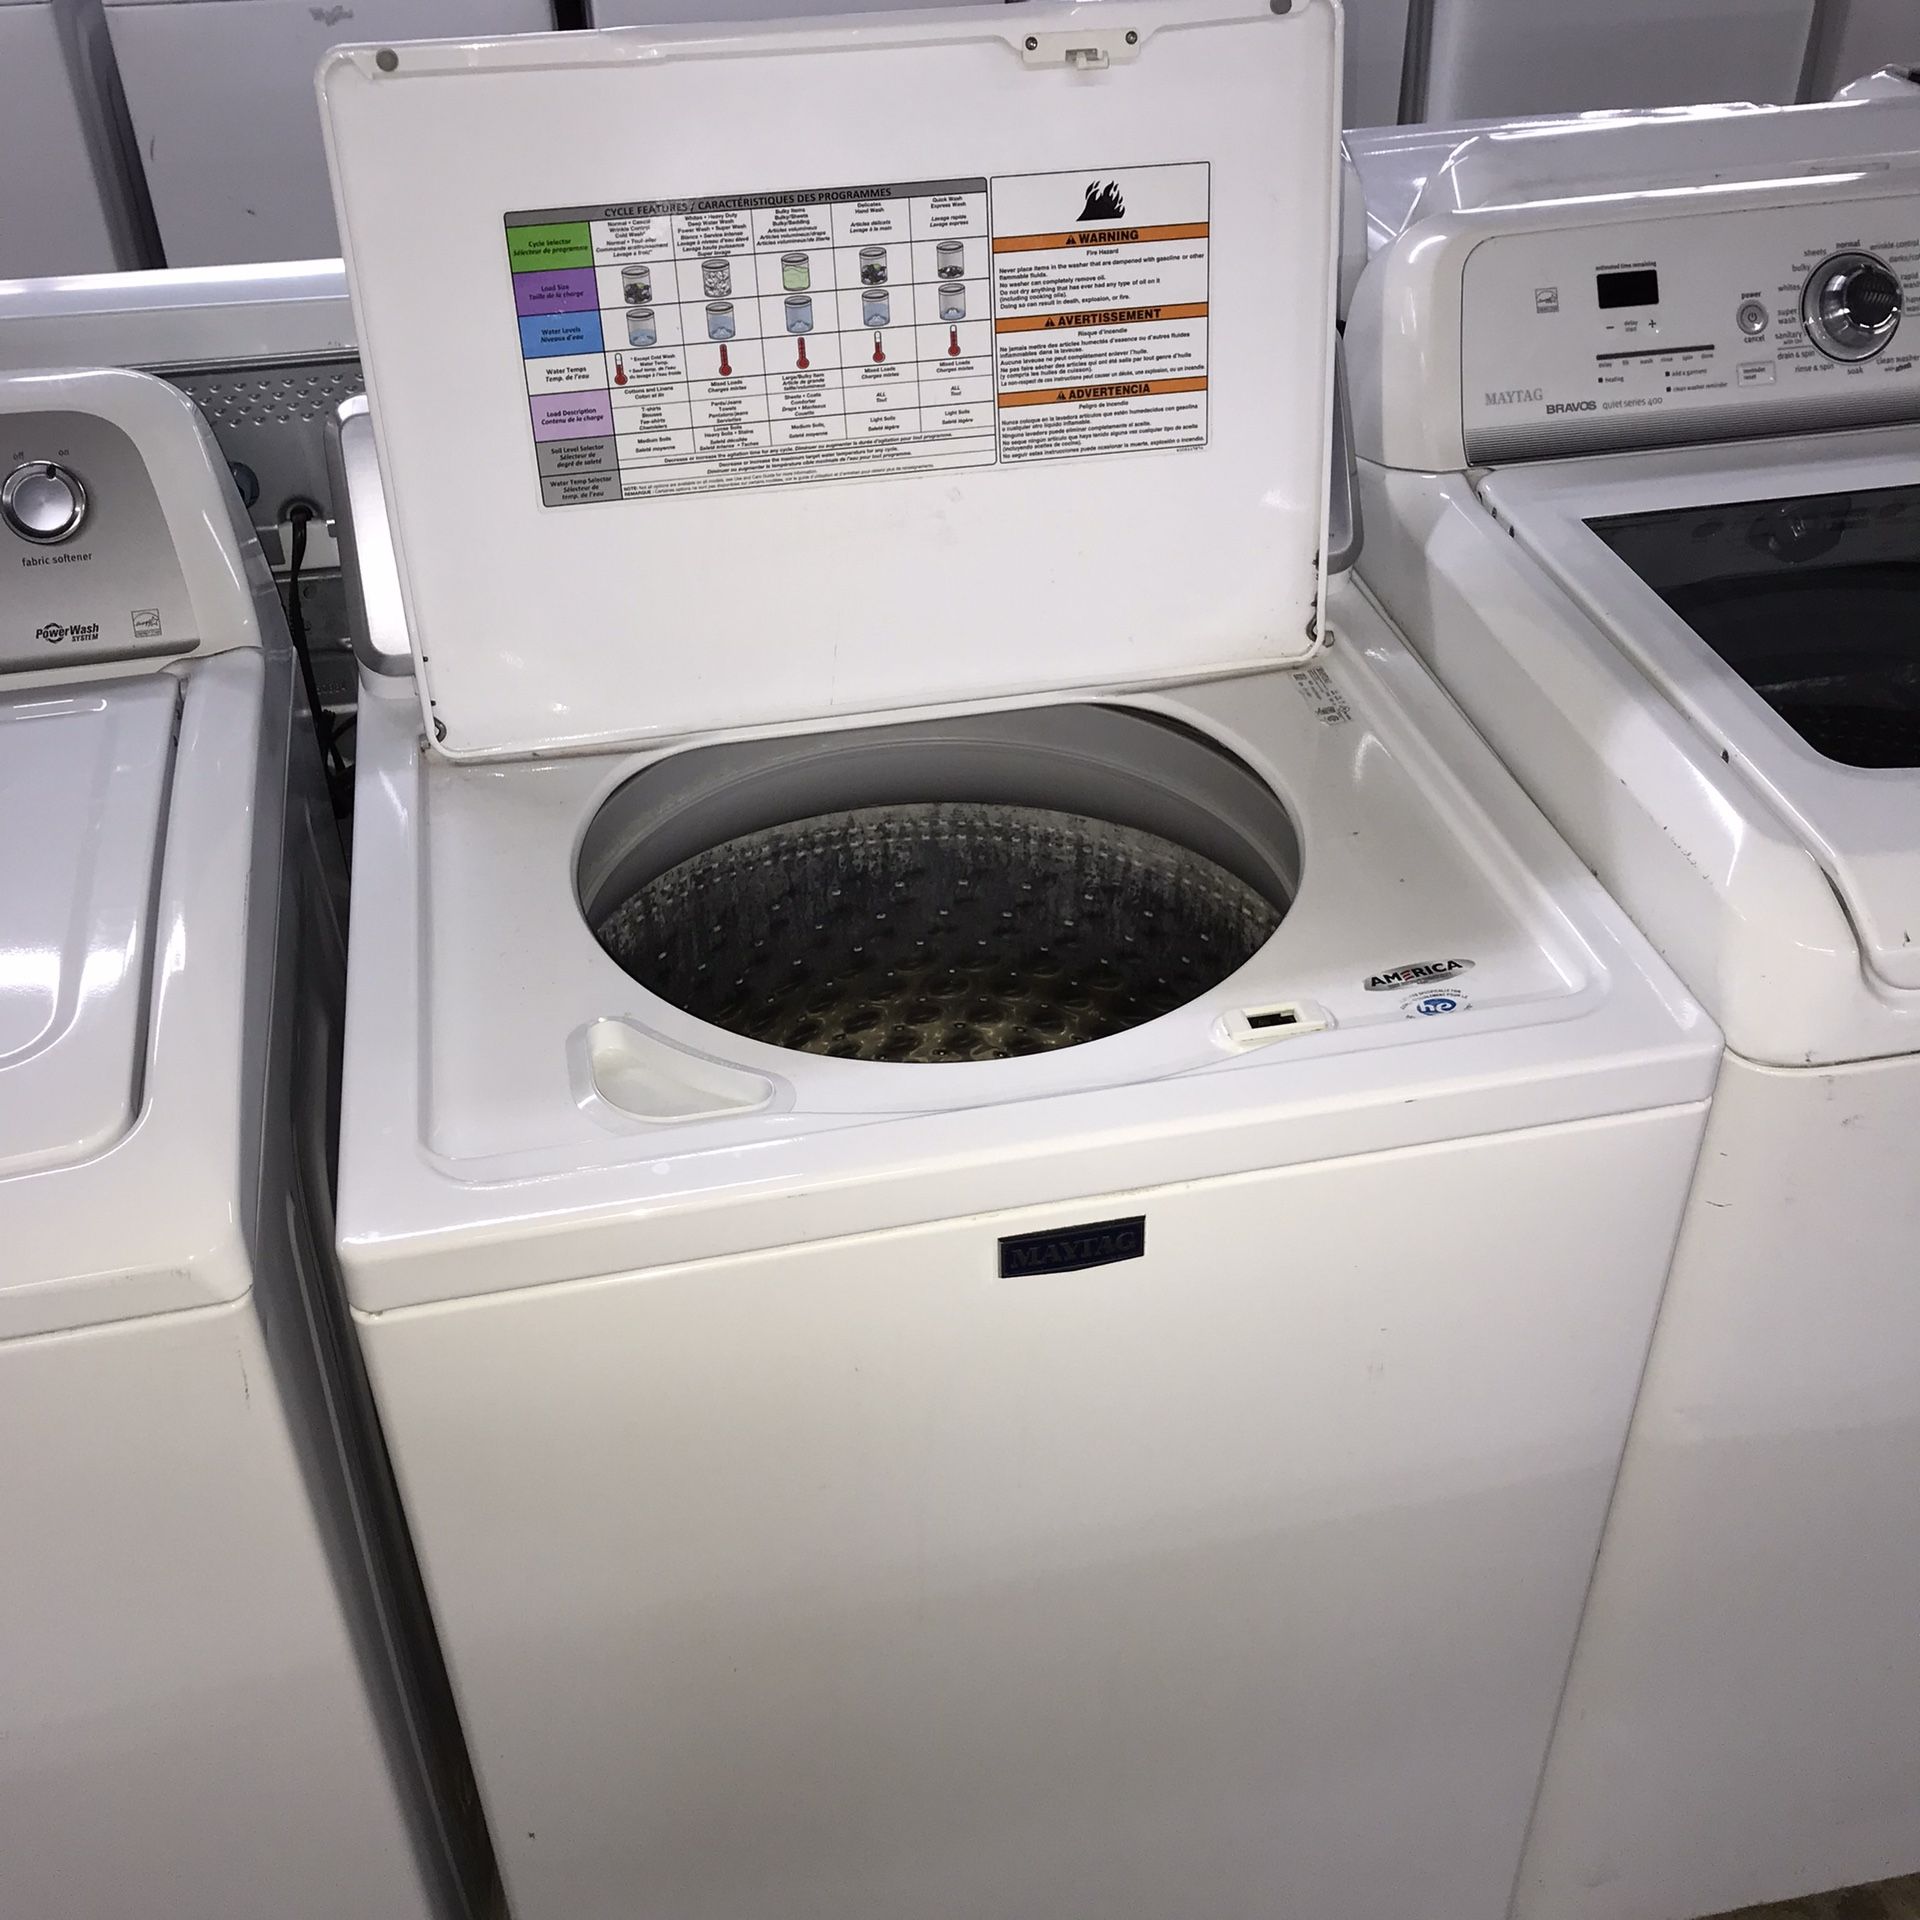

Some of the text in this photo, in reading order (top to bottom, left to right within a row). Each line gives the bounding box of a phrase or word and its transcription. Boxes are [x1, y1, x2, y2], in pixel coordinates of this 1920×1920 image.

[604, 207, 634, 217] CYCLE
[637, 202, 688, 215] FEATURES
[698, 194, 794, 210] CARACTÉRISTIQUES
[797, 193, 816, 202] DES
[819, 188, 891, 200] PROGRAMMES
[1079, 230, 1139, 243] WARNING
[546, 238, 571, 246] Selector
[1836, 240, 1860, 249] normal
[1870, 240, 1919, 250] wrinkle control
[552, 246, 588, 254] programme
[1804, 249, 1827, 257] sheets
[1156, 255, 1180, 263] gasoline
[1792, 264, 1810, 272] bulky
[1901, 272, 1918, 280] rapid
[1778, 284, 1800, 292] whites
[563, 290, 584, 298] charge
[1741, 292, 1761, 300] power
[1000, 295, 1028, 303] (including
[1778, 308, 1797, 316] super
[1058, 309, 1161, 325] AVERTISSEMENT
[1744, 335, 1765, 343] cancel
[1775, 332, 1802, 340] sanitary
[1777, 351, 1794, 360] drain
[1801, 350, 1815, 358] spin
[1877, 357, 1894, 365] clean
[566, 366, 586, 374] Temps
[1795, 365, 1812, 373] rinse
[1820, 363, 1834, 371] spin
[1848, 367, 1863, 375] soak
[1068, 384, 1150, 400] ADVERTENCIA
[1485, 388, 1543, 406] MAYTAG
[1546, 397, 1663, 414] BRAVOS quiet series 400
[546, 408, 596, 418] Load Description
[541, 417, 566, 425] Contenu
[13, 452, 24, 460] off
[556, 460, 574, 468] degré
[570, 478, 587, 486] Temp
[22, 552, 92, 567] fabric softener
[36, 623, 99, 640] PowerWash
[72, 634, 99, 642] SYSTEM
[1371, 960, 1463, 987] AMERICA
[1010, 1231, 1136, 1269] MAYTAG
